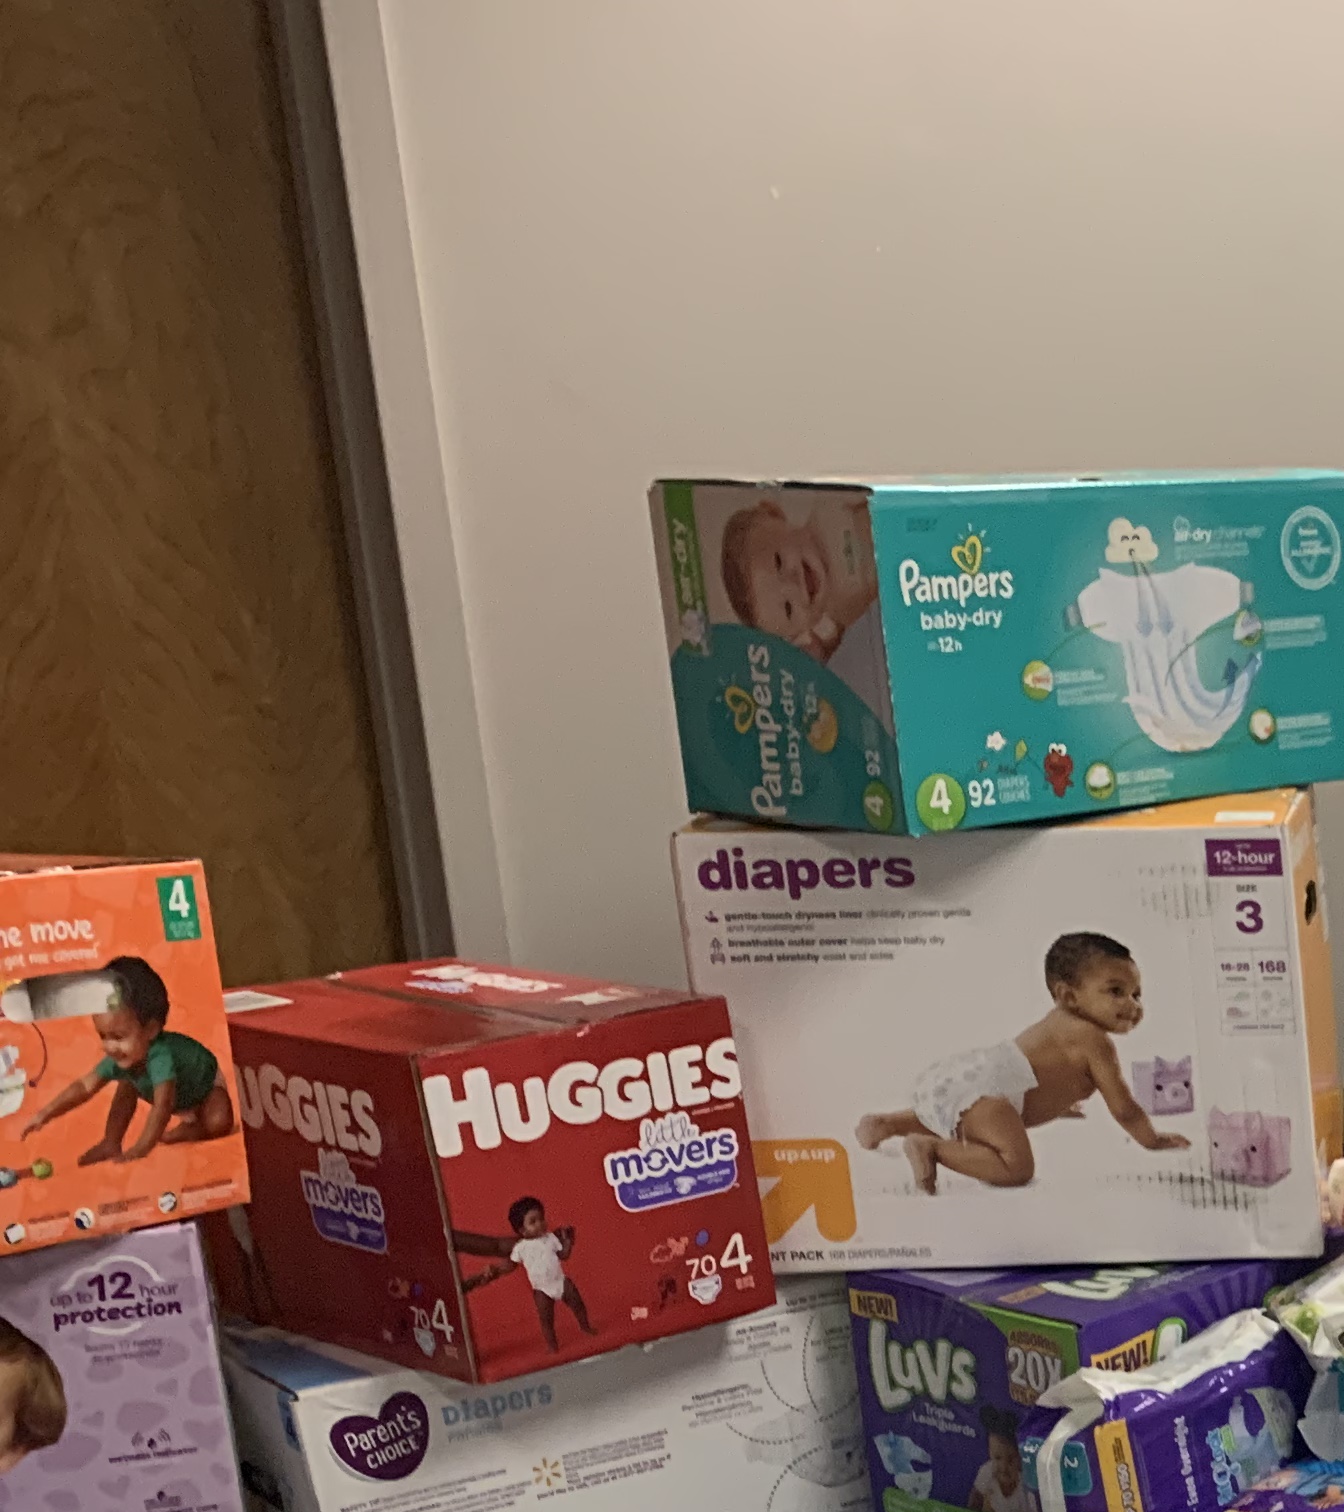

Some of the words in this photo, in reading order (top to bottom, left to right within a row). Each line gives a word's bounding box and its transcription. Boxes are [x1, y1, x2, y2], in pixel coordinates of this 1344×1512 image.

[900, 558, 1014, 606] Pampers
[920, 609, 1003, 632] baby-dry
[750, 643, 787, 818] Pampers
[786, 669, 804, 796] baby-dry
[866, 750, 882, 776] 92
[929, 778, 951, 814] 4
[968, 780, 996, 807] 92
[698, 848, 916, 900] diapers
[1214, 851, 1275, 865] 12-hour
[168, 879, 190, 918] 4
[30, 918, 95, 943] move
[1236, 900, 1264, 934] 3
[1258, 961, 1286, 973] 168
[421, 1036, 742, 1159] HUGGIES
[609, 1126, 736, 1179] movers
[685, 1255, 718, 1279] 70
[720, 1231, 752, 1278] 4
[790, 1248, 824, 1261] PACK
[88, 1272, 134, 1302] 12
[140, 1281, 178, 1297] hour
[53, 1298, 182, 1331] protection
[431, 1298, 455, 1335] 4
[856, 1293, 893, 1318] NEW!
[868, 1318, 977, 1413] Luvs
[441, 1382, 554, 1426] Diapers
[343, 1408, 422, 1457] Parent's
[366, 1437, 419, 1471] CHOICE
